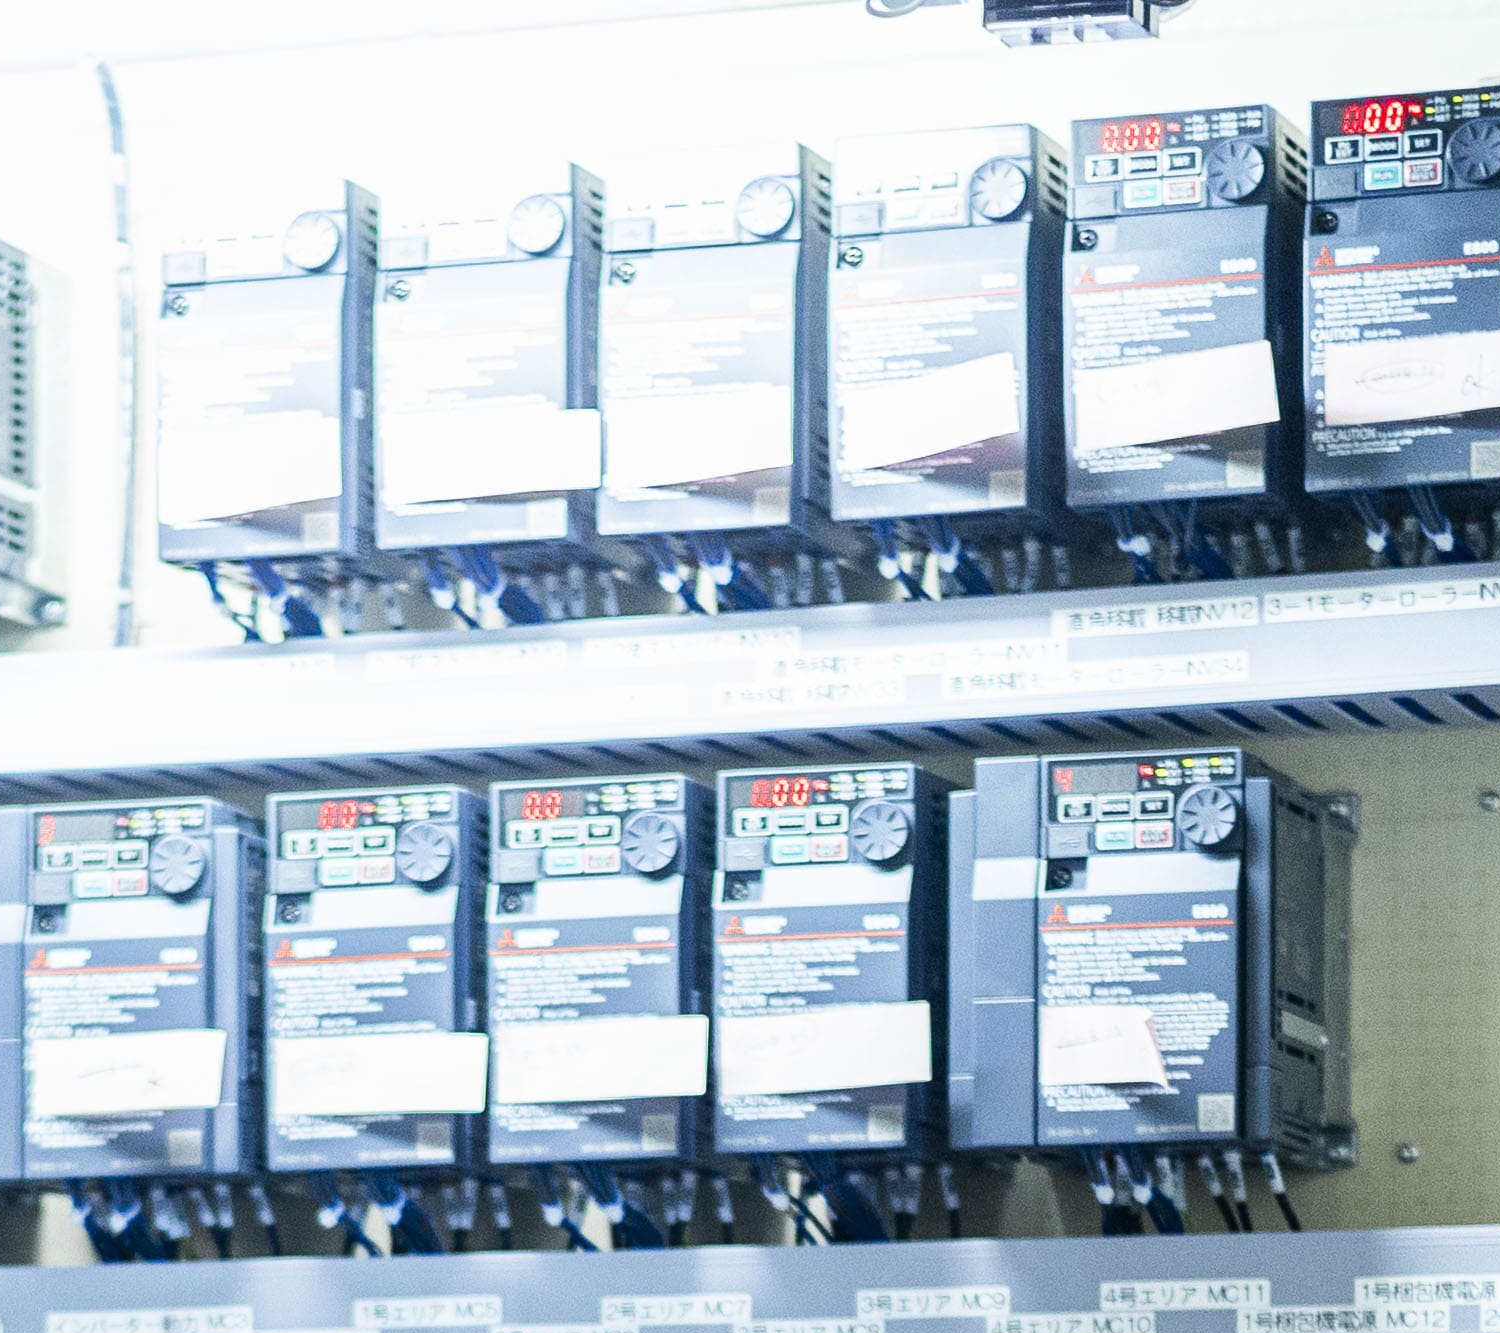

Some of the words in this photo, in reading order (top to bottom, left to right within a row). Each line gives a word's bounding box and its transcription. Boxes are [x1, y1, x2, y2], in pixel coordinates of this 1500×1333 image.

[962, 1291, 1006, 1311] MC9
[1207, 1284, 1266, 1305] MC11
[704, 1299, 748, 1319] MC7
